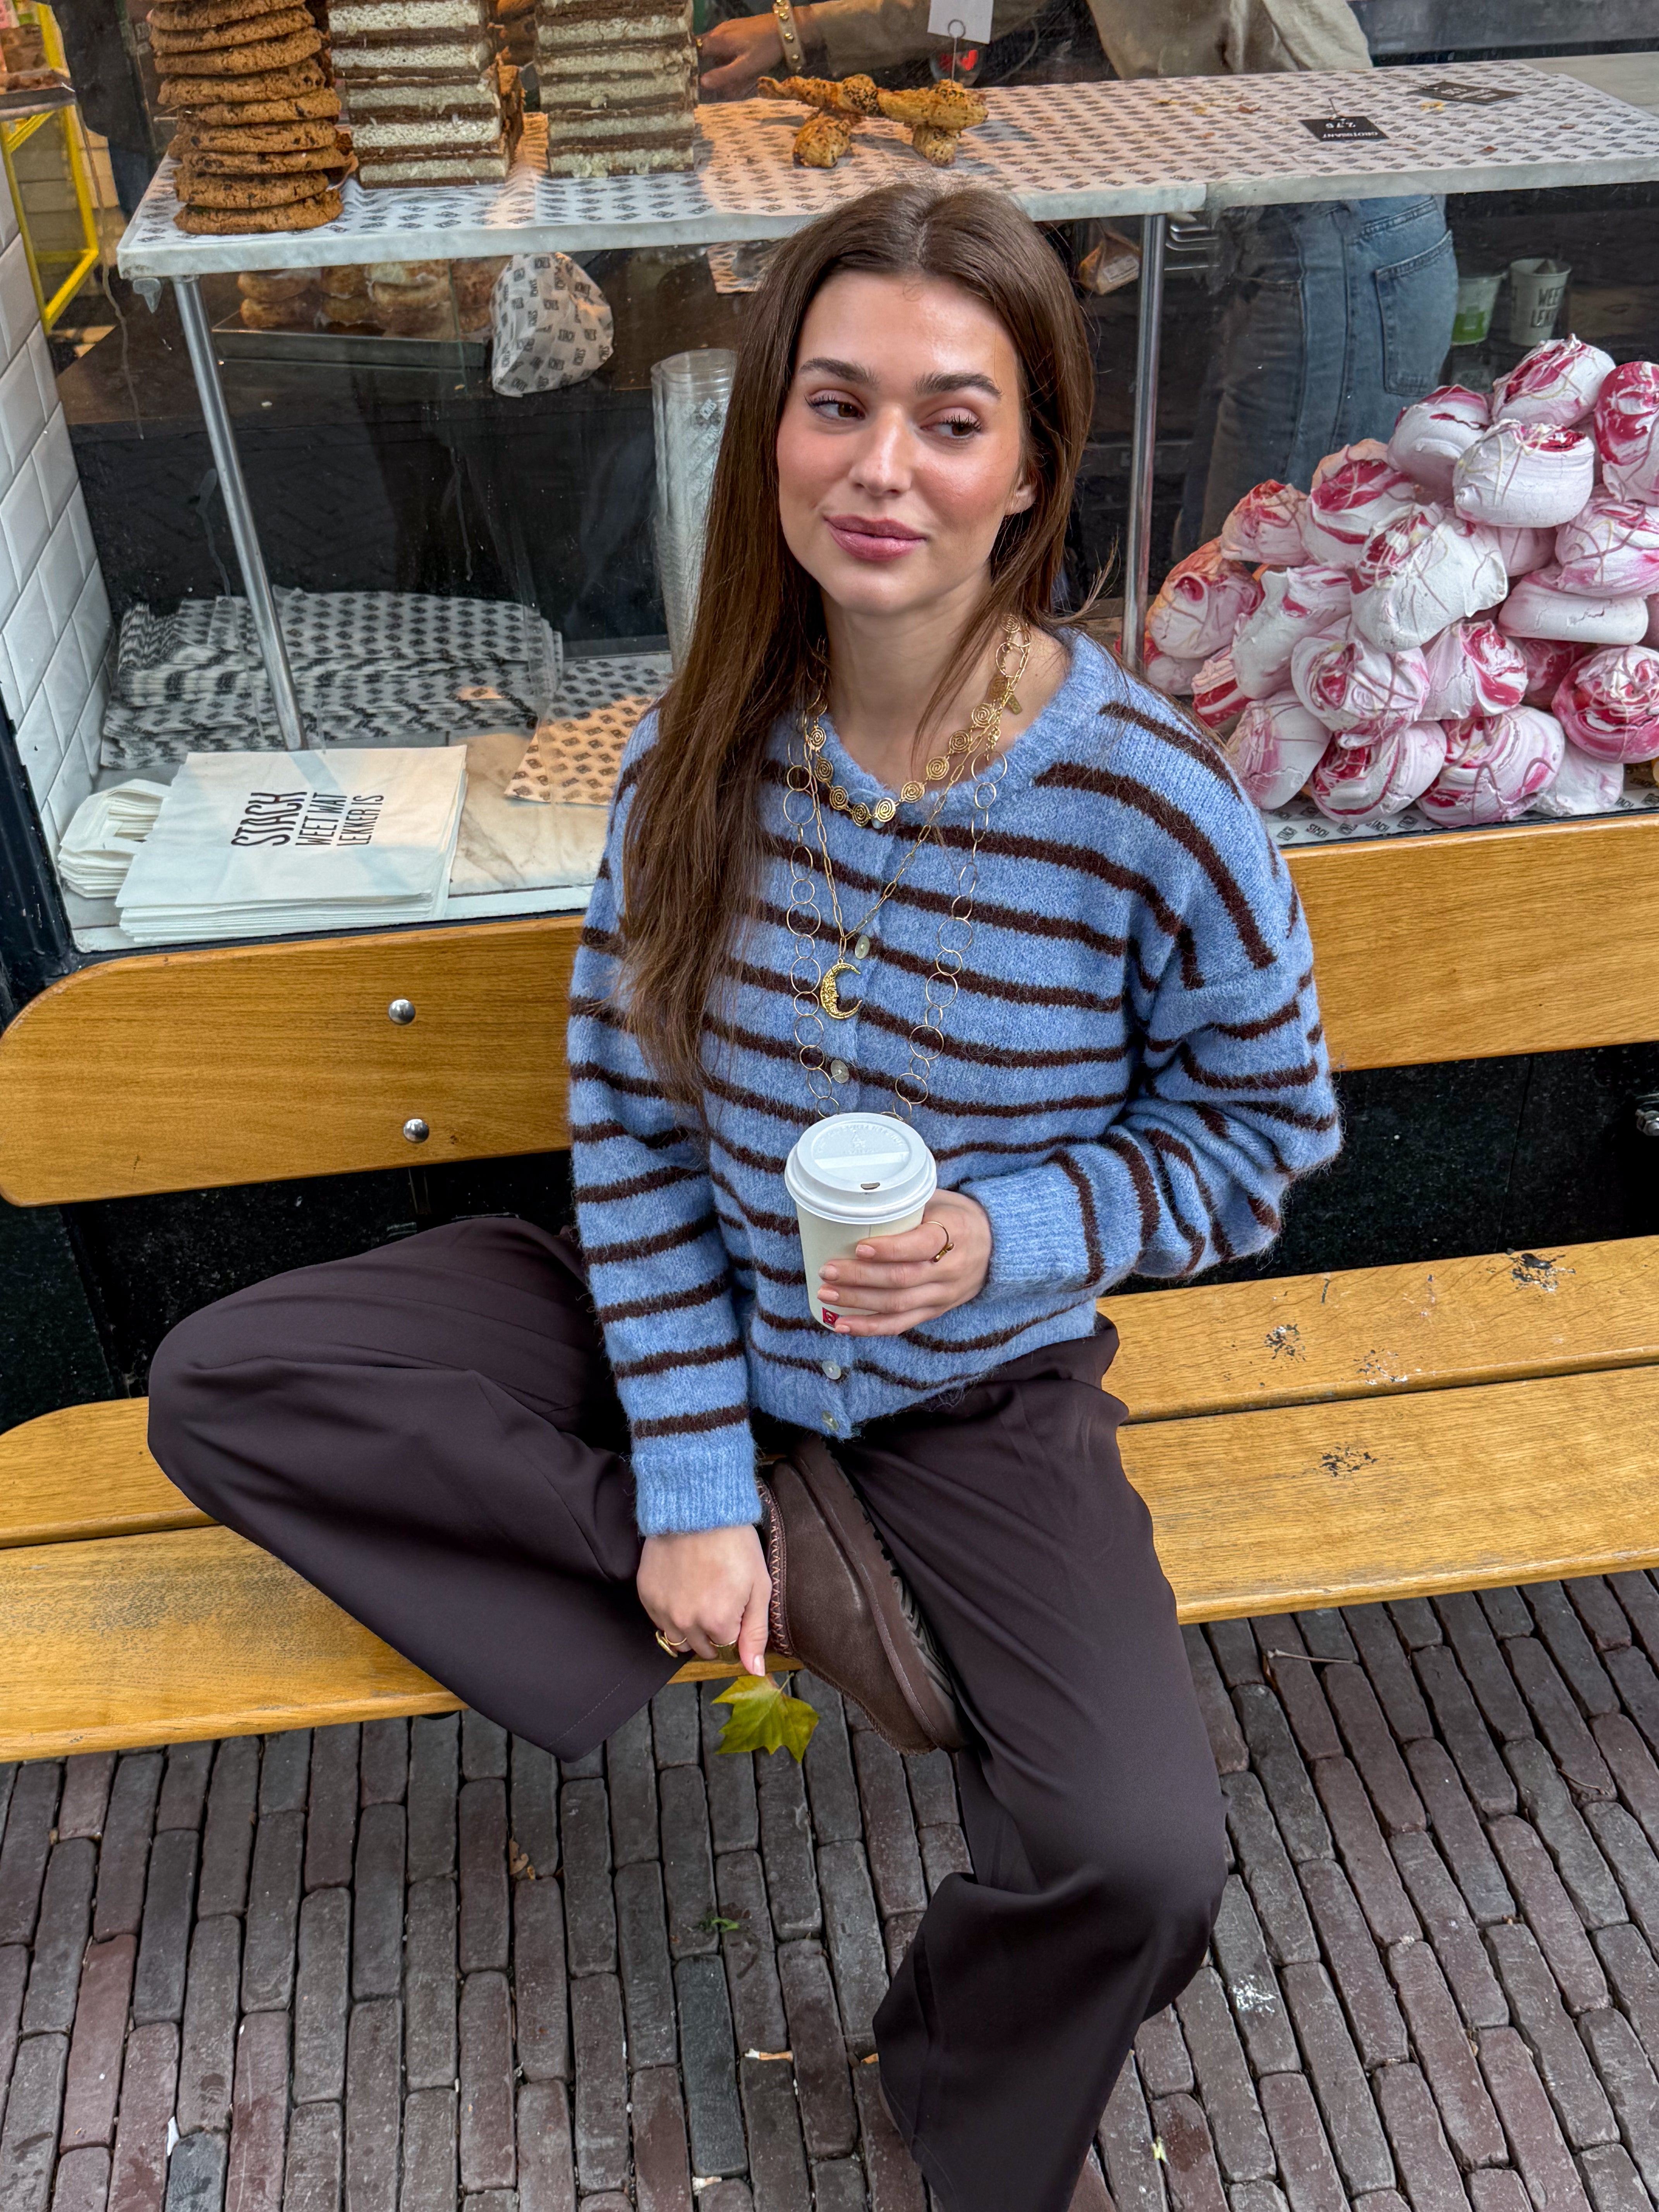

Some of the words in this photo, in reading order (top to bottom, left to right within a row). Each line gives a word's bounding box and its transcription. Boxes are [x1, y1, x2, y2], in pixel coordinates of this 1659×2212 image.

[307, 792, 347, 814] WAT
[351, 795, 384, 805] IS
[231, 792, 307, 846] STACH
[295, 816, 339, 845] WEET
[337, 809, 381, 846] LEKKER
[1305, 824, 1329, 838] STACH
